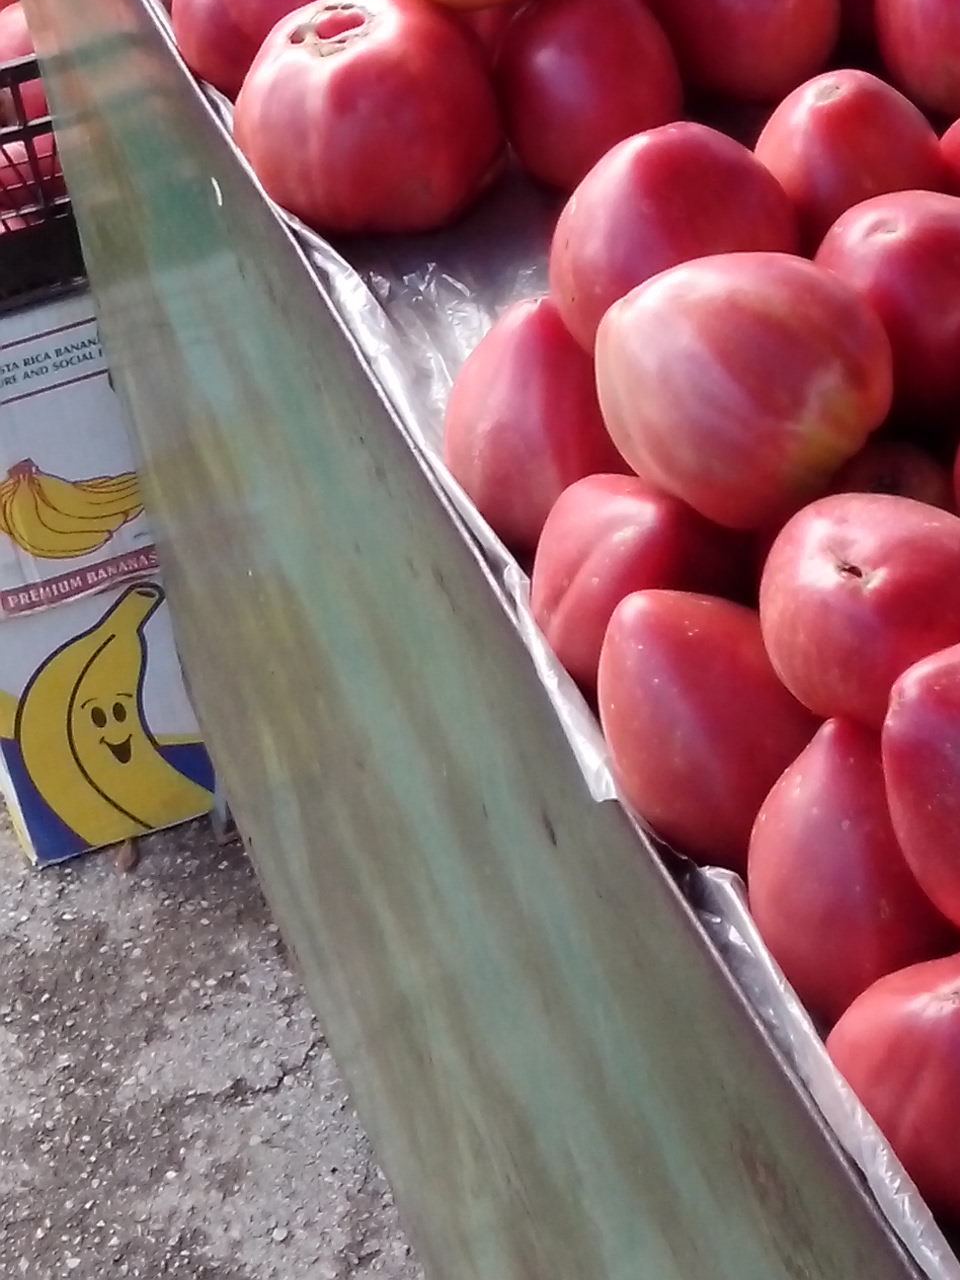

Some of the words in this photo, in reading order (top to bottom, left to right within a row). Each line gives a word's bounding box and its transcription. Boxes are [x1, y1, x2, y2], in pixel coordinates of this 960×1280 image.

[23, 351, 52, 367] RICA
[23, 366, 49, 380] AND
[52, 351, 96, 371] SOCIAL
[7, 576, 82, 609] PREMIUM
[86, 550, 158, 584] BANANAS
